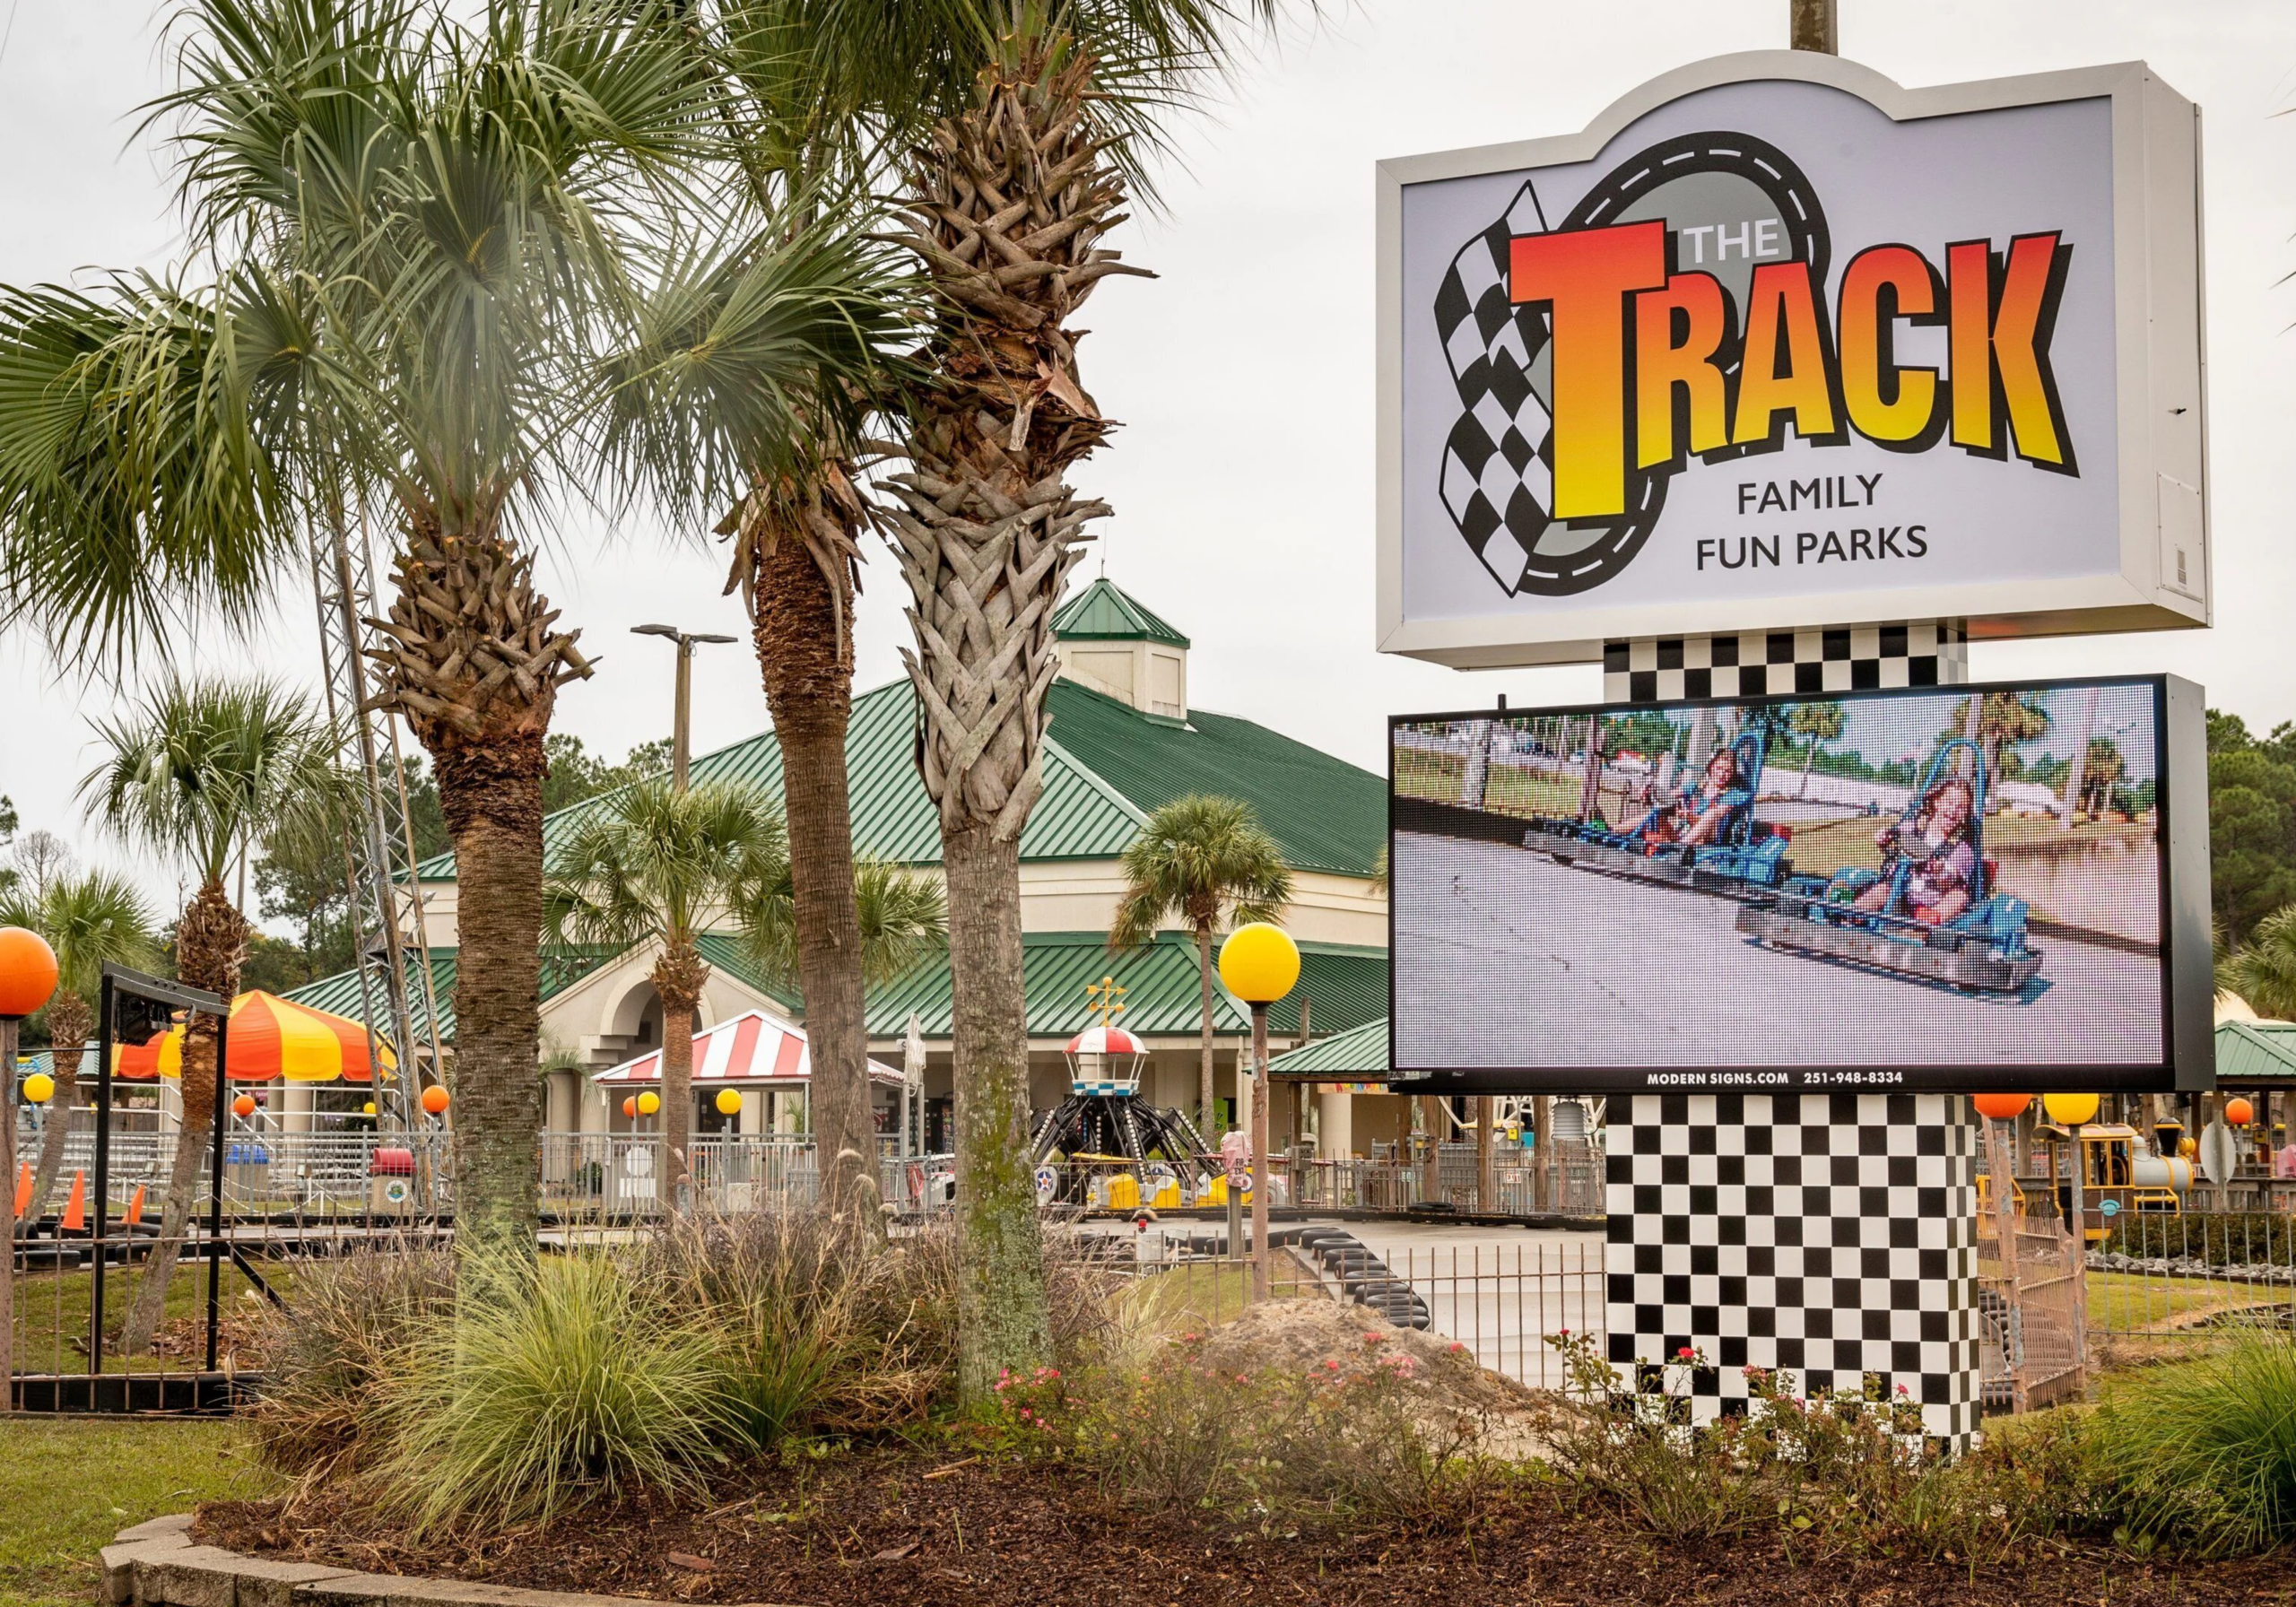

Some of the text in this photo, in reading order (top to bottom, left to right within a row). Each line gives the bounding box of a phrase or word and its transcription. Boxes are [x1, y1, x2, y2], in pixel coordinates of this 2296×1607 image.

[1683, 218, 1779, 263] THE
[1509, 218, 2079, 527] TRACK
[1738, 473, 1883, 515] FAMILY
[1697, 525, 1928, 570] FUN PARKS
[1647, 1072, 1903, 1085] MODERN SIGNS.COM 251-948-8334
